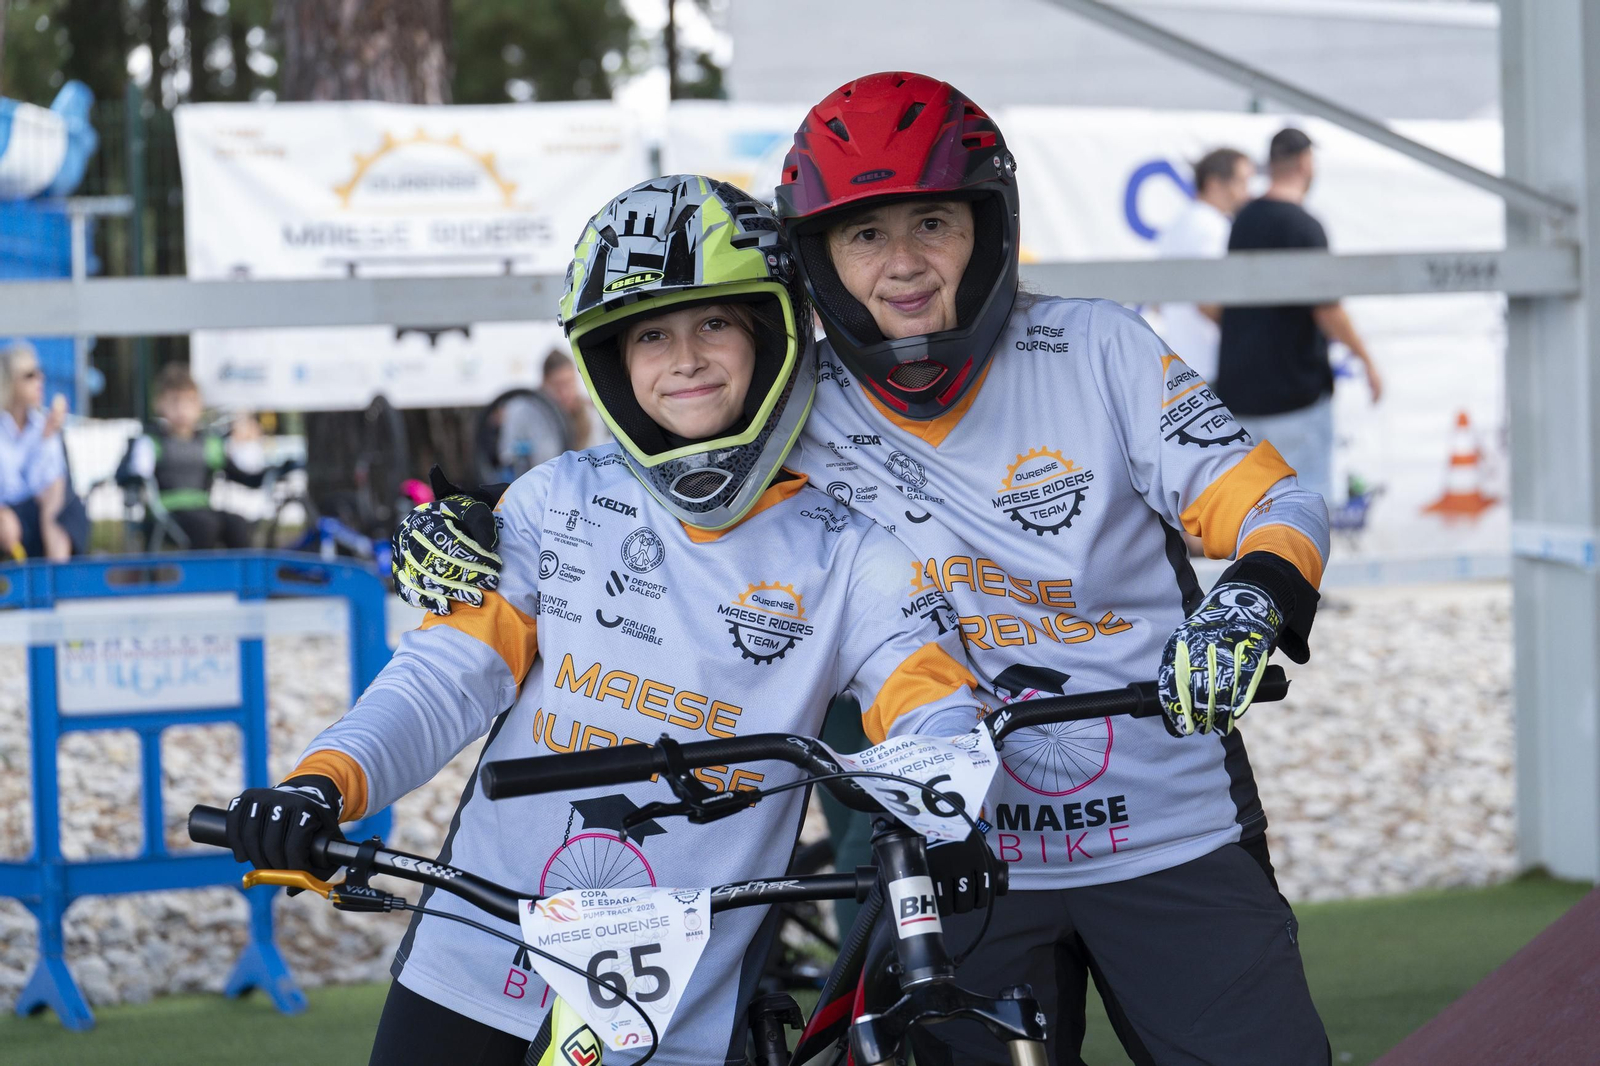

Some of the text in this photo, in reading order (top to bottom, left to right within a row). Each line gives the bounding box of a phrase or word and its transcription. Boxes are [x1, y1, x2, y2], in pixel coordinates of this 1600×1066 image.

[857, 171, 889, 182] BELL
[611, 274, 655, 290] BELL
[1026, 324, 1066, 338] MAESE
[1015, 340, 1070, 353] OURENSE
[1166, 368, 1200, 392] OURENS
[1160, 394, 1204, 433] AESE
[1014, 460, 1059, 483] OURENSE
[991, 470, 1095, 510] MAESE RIDERS
[592, 494, 638, 518] KELTA
[1030, 501, 1068, 521] TEAM
[559, 570, 581, 582] Galego
[562, 563, 586, 574] Ciclismo
[628, 584, 662, 600] GALEGO
[631, 578, 668, 594] DEPORTE
[752, 594, 794, 611] OURENSE
[901, 590, 945, 618] MAES
[546, 606, 582, 624] GALICIA
[717, 604, 814, 636] MAESE RIDERS
[621, 626, 664, 646] SAUDABLE
[624, 618, 656, 634] GALICIA
[956, 610, 1134, 651] RENSE
[746, 634, 780, 650] TEAM
[554, 653, 743, 738] MAESE
[533, 707, 765, 807] OURSE
[860, 744, 886, 759] COPA
[866, 746, 938, 772] PUMP TRACK 2026
[878, 740, 917, 760] ESPAÑA
[874, 774, 966, 818] 36
[228, 797, 311, 827] FIST
[996, 795, 1129, 832] MAESE
[580, 890, 608, 898] COPA
[937, 872, 990, 897] IST
[582, 896, 637, 908] DE ESPAÑA
[584, 903, 656, 920] PUMP TRACK 2026
[900, 894, 937, 920] BH
[538, 916, 670, 947] MAESE OURENSE
[586, 942, 670, 1010] 65
[503, 968, 550, 1008] BI
